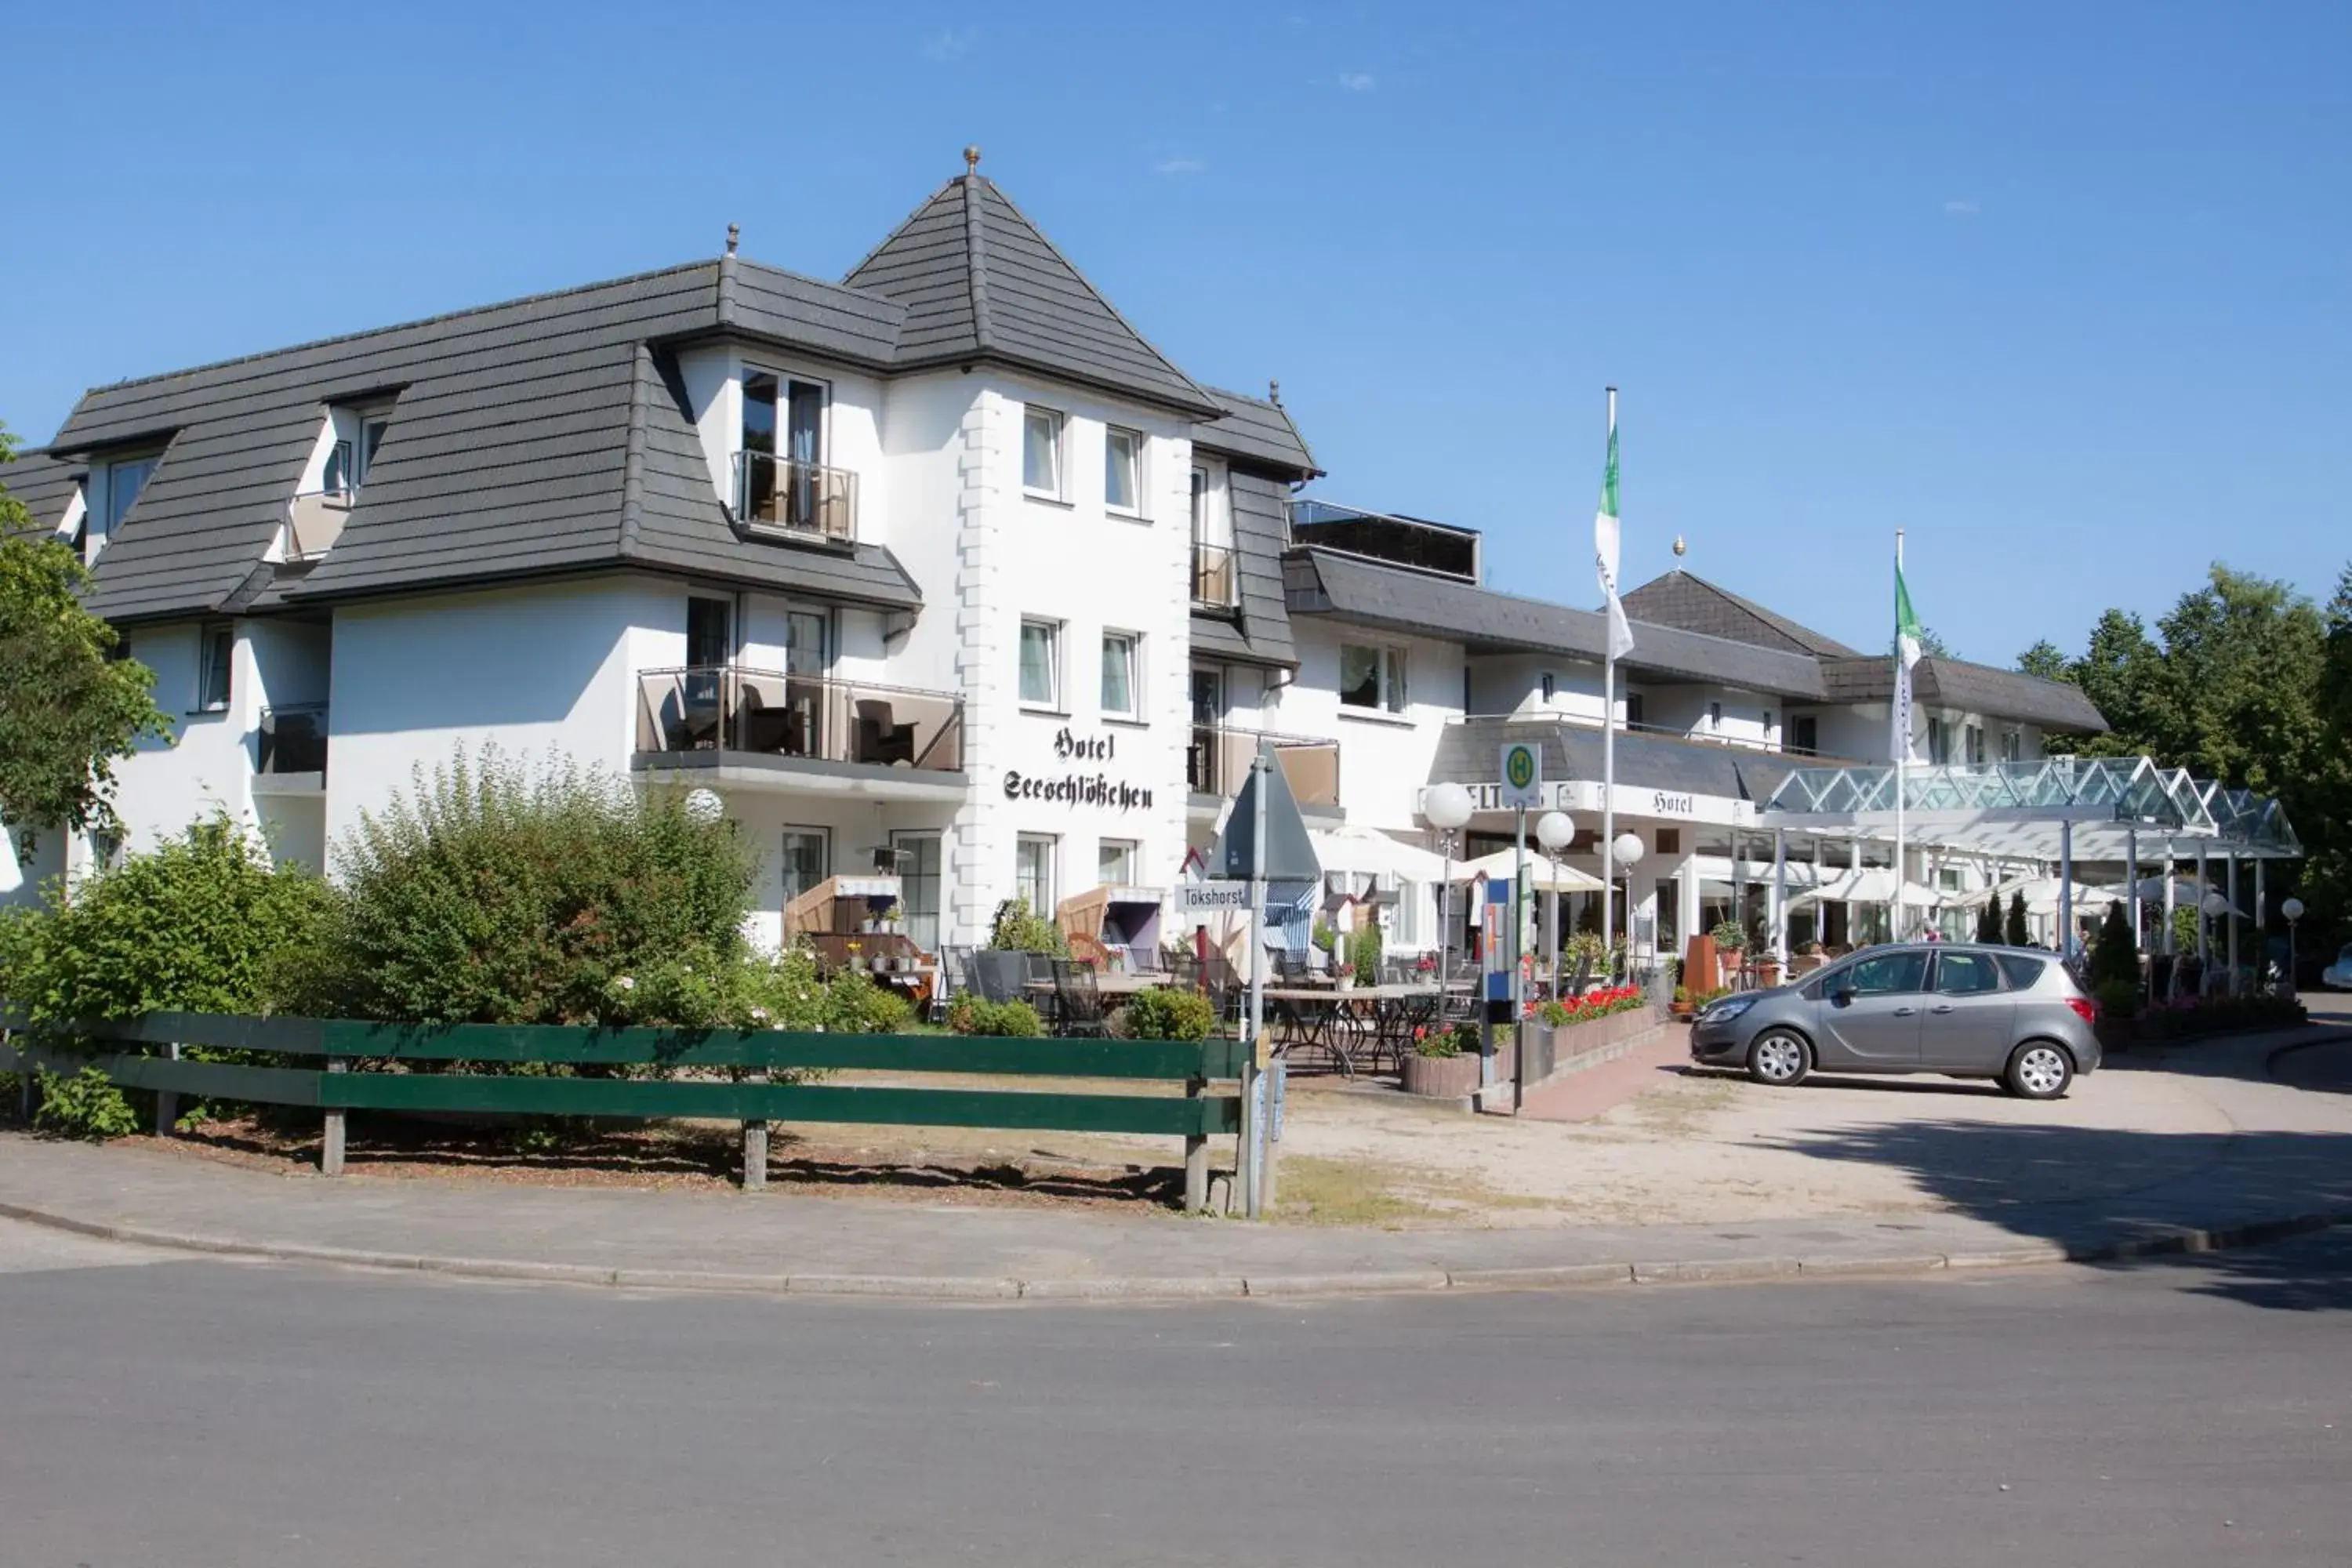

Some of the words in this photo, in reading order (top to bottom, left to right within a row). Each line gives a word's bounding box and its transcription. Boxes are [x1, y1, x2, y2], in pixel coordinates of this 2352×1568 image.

[1054, 728, 1114, 763] Hotel
[1514, 757, 1526, 780] H
[1652, 791, 1693, 814] Hotel
[1185, 887, 1243, 906] Tökshorst
